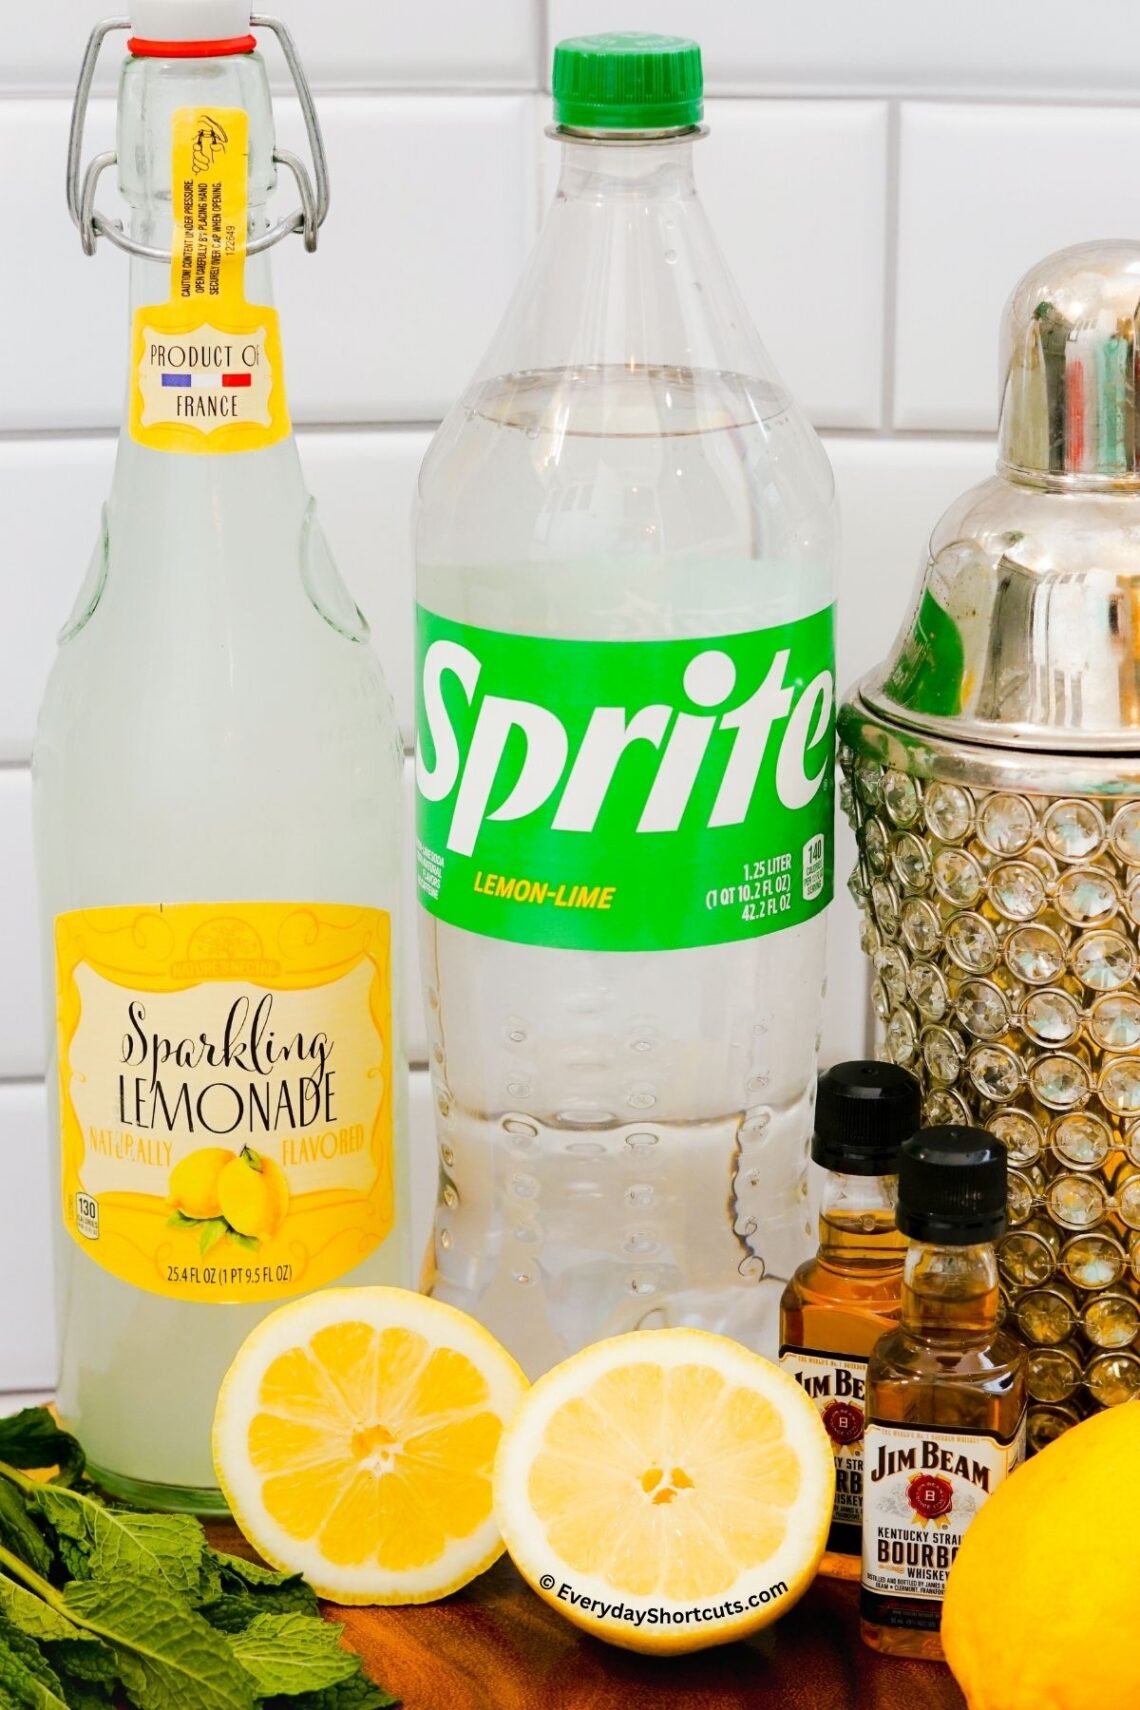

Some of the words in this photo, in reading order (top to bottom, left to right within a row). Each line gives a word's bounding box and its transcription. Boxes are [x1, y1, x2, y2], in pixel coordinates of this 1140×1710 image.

[198, 183, 208, 201] HAND
[198, 203, 208, 231] PLACING
[212, 213, 222, 232] WHEN
[182, 240, 193, 268] CONTENT
[225, 225, 235, 256] 122649
[196, 244, 207, 275] CAREFULLY
[211, 250, 221, 265] OVER
[195, 276, 205, 294] OPEN
[209, 266, 220, 295] SECURELY
[150, 344, 233, 368] PRODUCT
[241, 344, 260, 367] OF
[176, 395, 238, 417] FRANCE
[415, 639, 833, 857] Sprite
[807, 839, 822, 864] 140
[743, 860, 766, 881] 1.25
[767, 853, 792, 876] LITER
[473, 870, 616, 910] LEMON-LIME
[705, 889, 718, 911] (1
[720, 886, 736, 906] QT
[737, 882, 761, 903] 10.2
[762, 879, 773, 897] FL
[775, 874, 791, 893] OZ)
[742, 900, 766, 921] 42.2
[767, 898, 778, 916] FL
[779, 893, 791, 912] OZ
[120, 993, 335, 1101] Sparkling
[119, 1071, 338, 1135] LEMONADE
[88, 1125, 174, 1168] NATURALLY
[281, 1123, 365, 1167] FLAVORED
[78, 1197, 96, 1219] 130
[167, 1265, 188, 1282] 25.4
[190, 1267, 201, 1283] FL
[203, 1268, 216, 1284] OZ
[218, 1268, 227, 1286] (1
[231, 1268, 243, 1284] PT
[245, 1267, 260, 1283] 9.5
[263, 1266, 273, 1283] FL
[276, 1264, 293, 1282] OZ)
[835, 1368, 865, 1401] BE
[871, 1445, 917, 1482] JIM
[920, 1440, 991, 1495] BEAM
[834, 1493, 863, 1507] ISKEY
[877, 1526, 929, 1542] KENTUCKY
[932, 1532, 962, 1546] STRAI
[877, 1538, 960, 1569] BOURB
